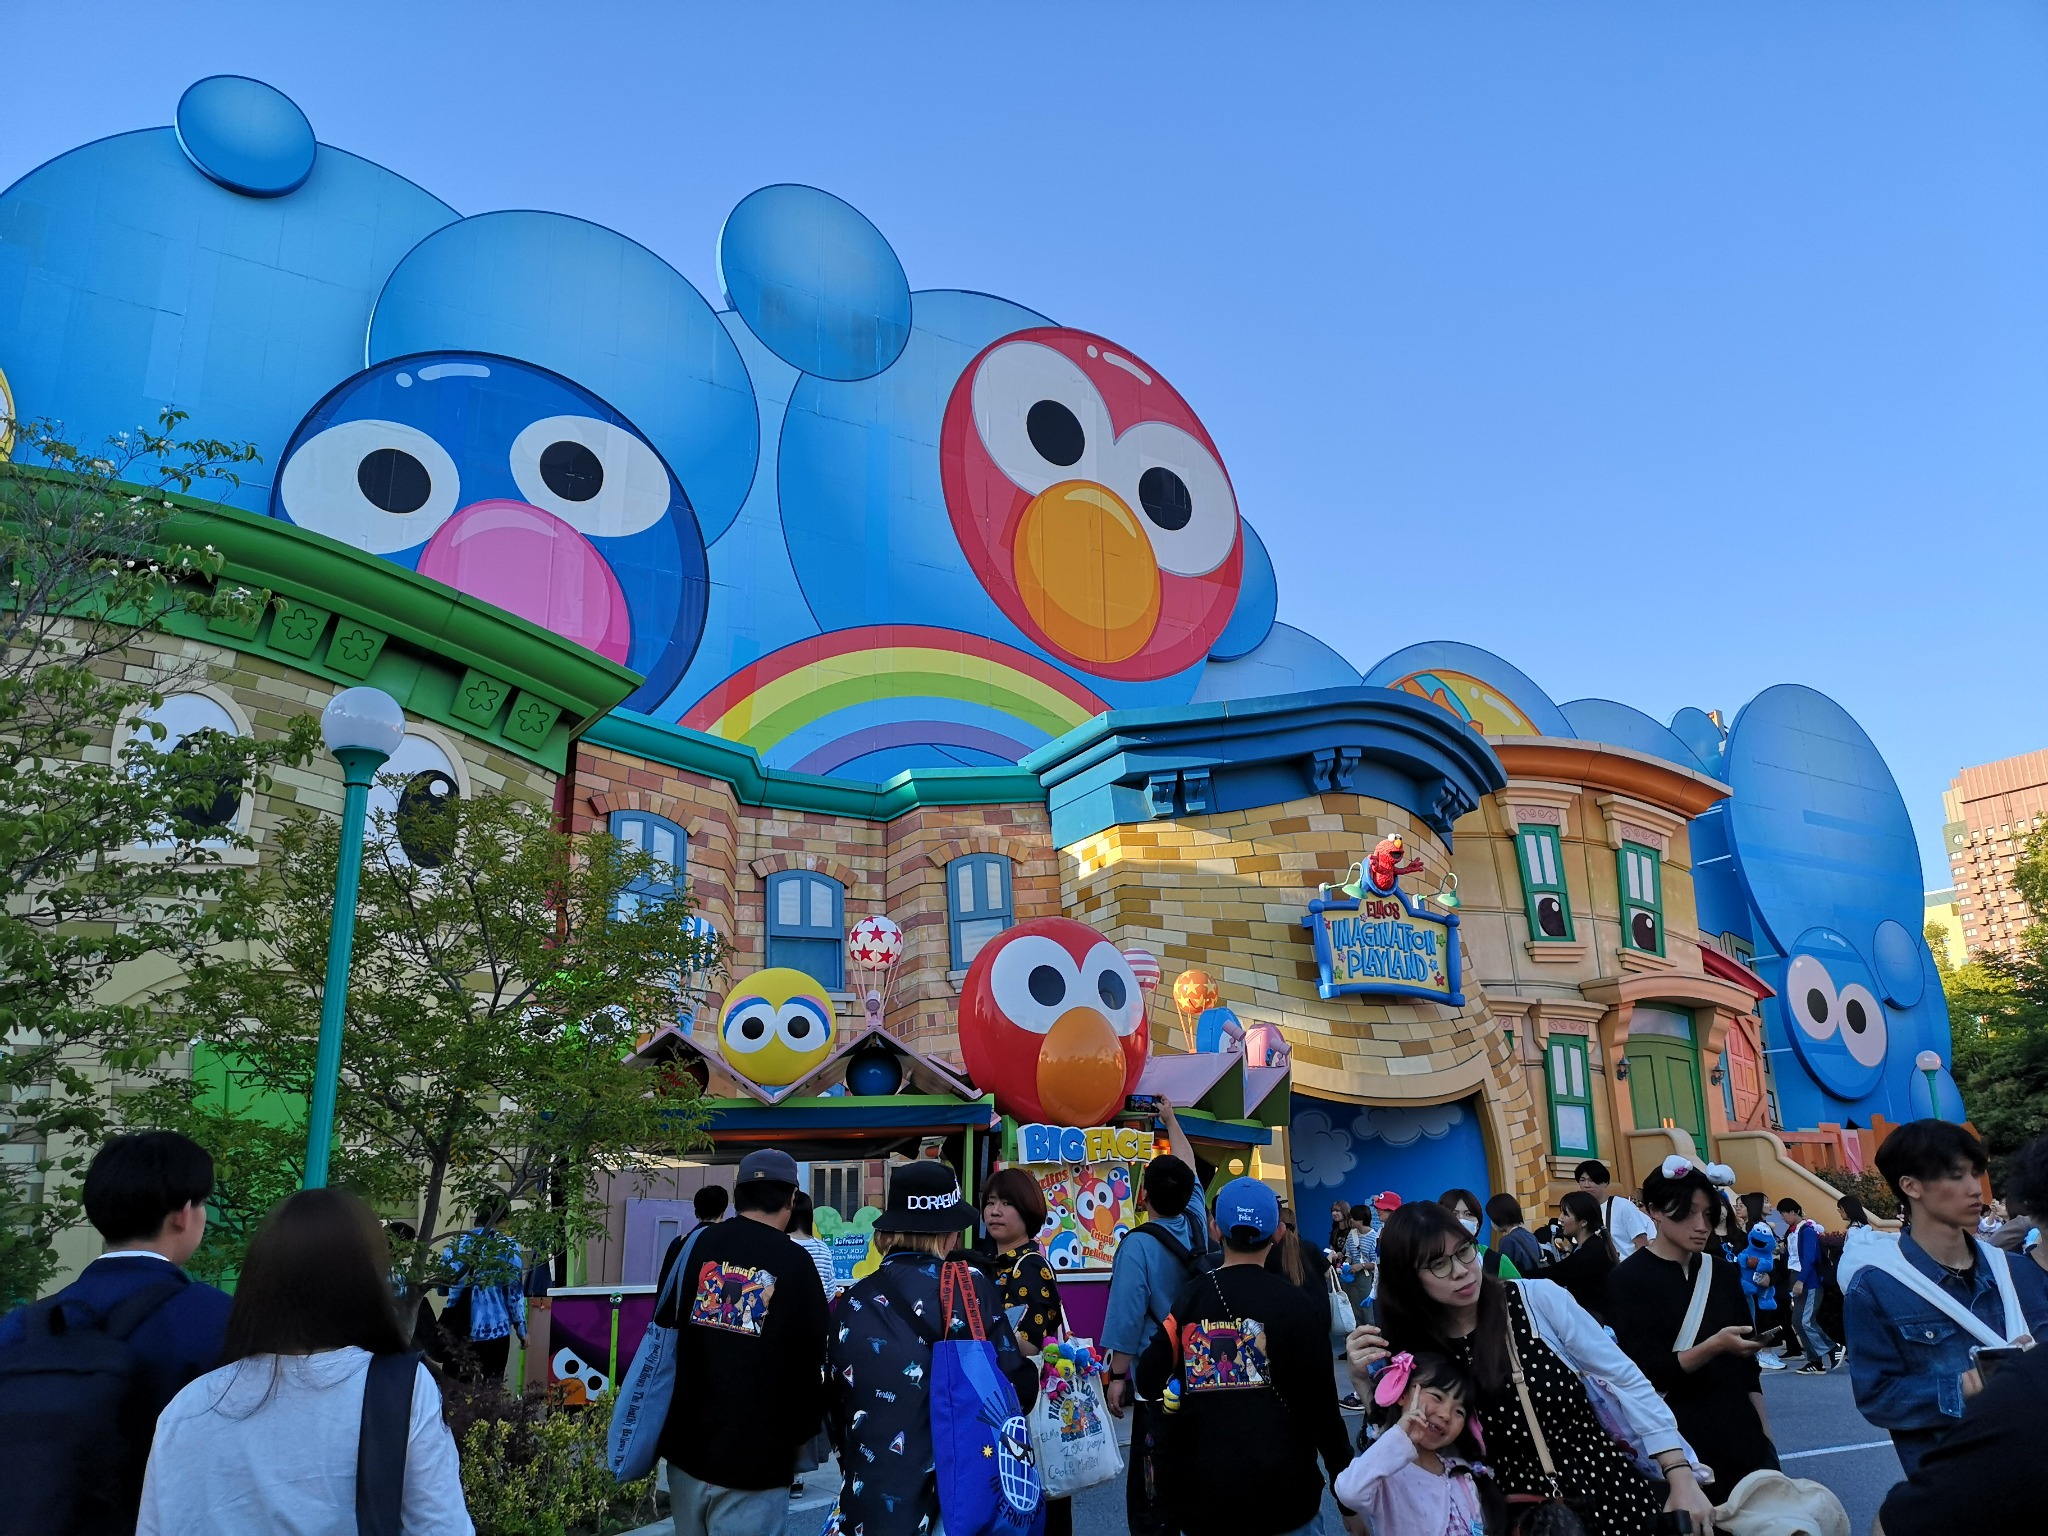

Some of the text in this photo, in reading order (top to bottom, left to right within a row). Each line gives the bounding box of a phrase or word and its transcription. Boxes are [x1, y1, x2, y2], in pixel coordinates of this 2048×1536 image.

[1366, 900, 1400, 920] ELMO'S
[1347, 947, 1429, 982] PLAYLAND
[1024, 1124, 1153, 1162] BIG FACE
[1081, 1246, 1113, 1263] Deliciou
[874, 1389, 897, 1403] Fortify
[858, 1442, 877, 1463] Fortify
